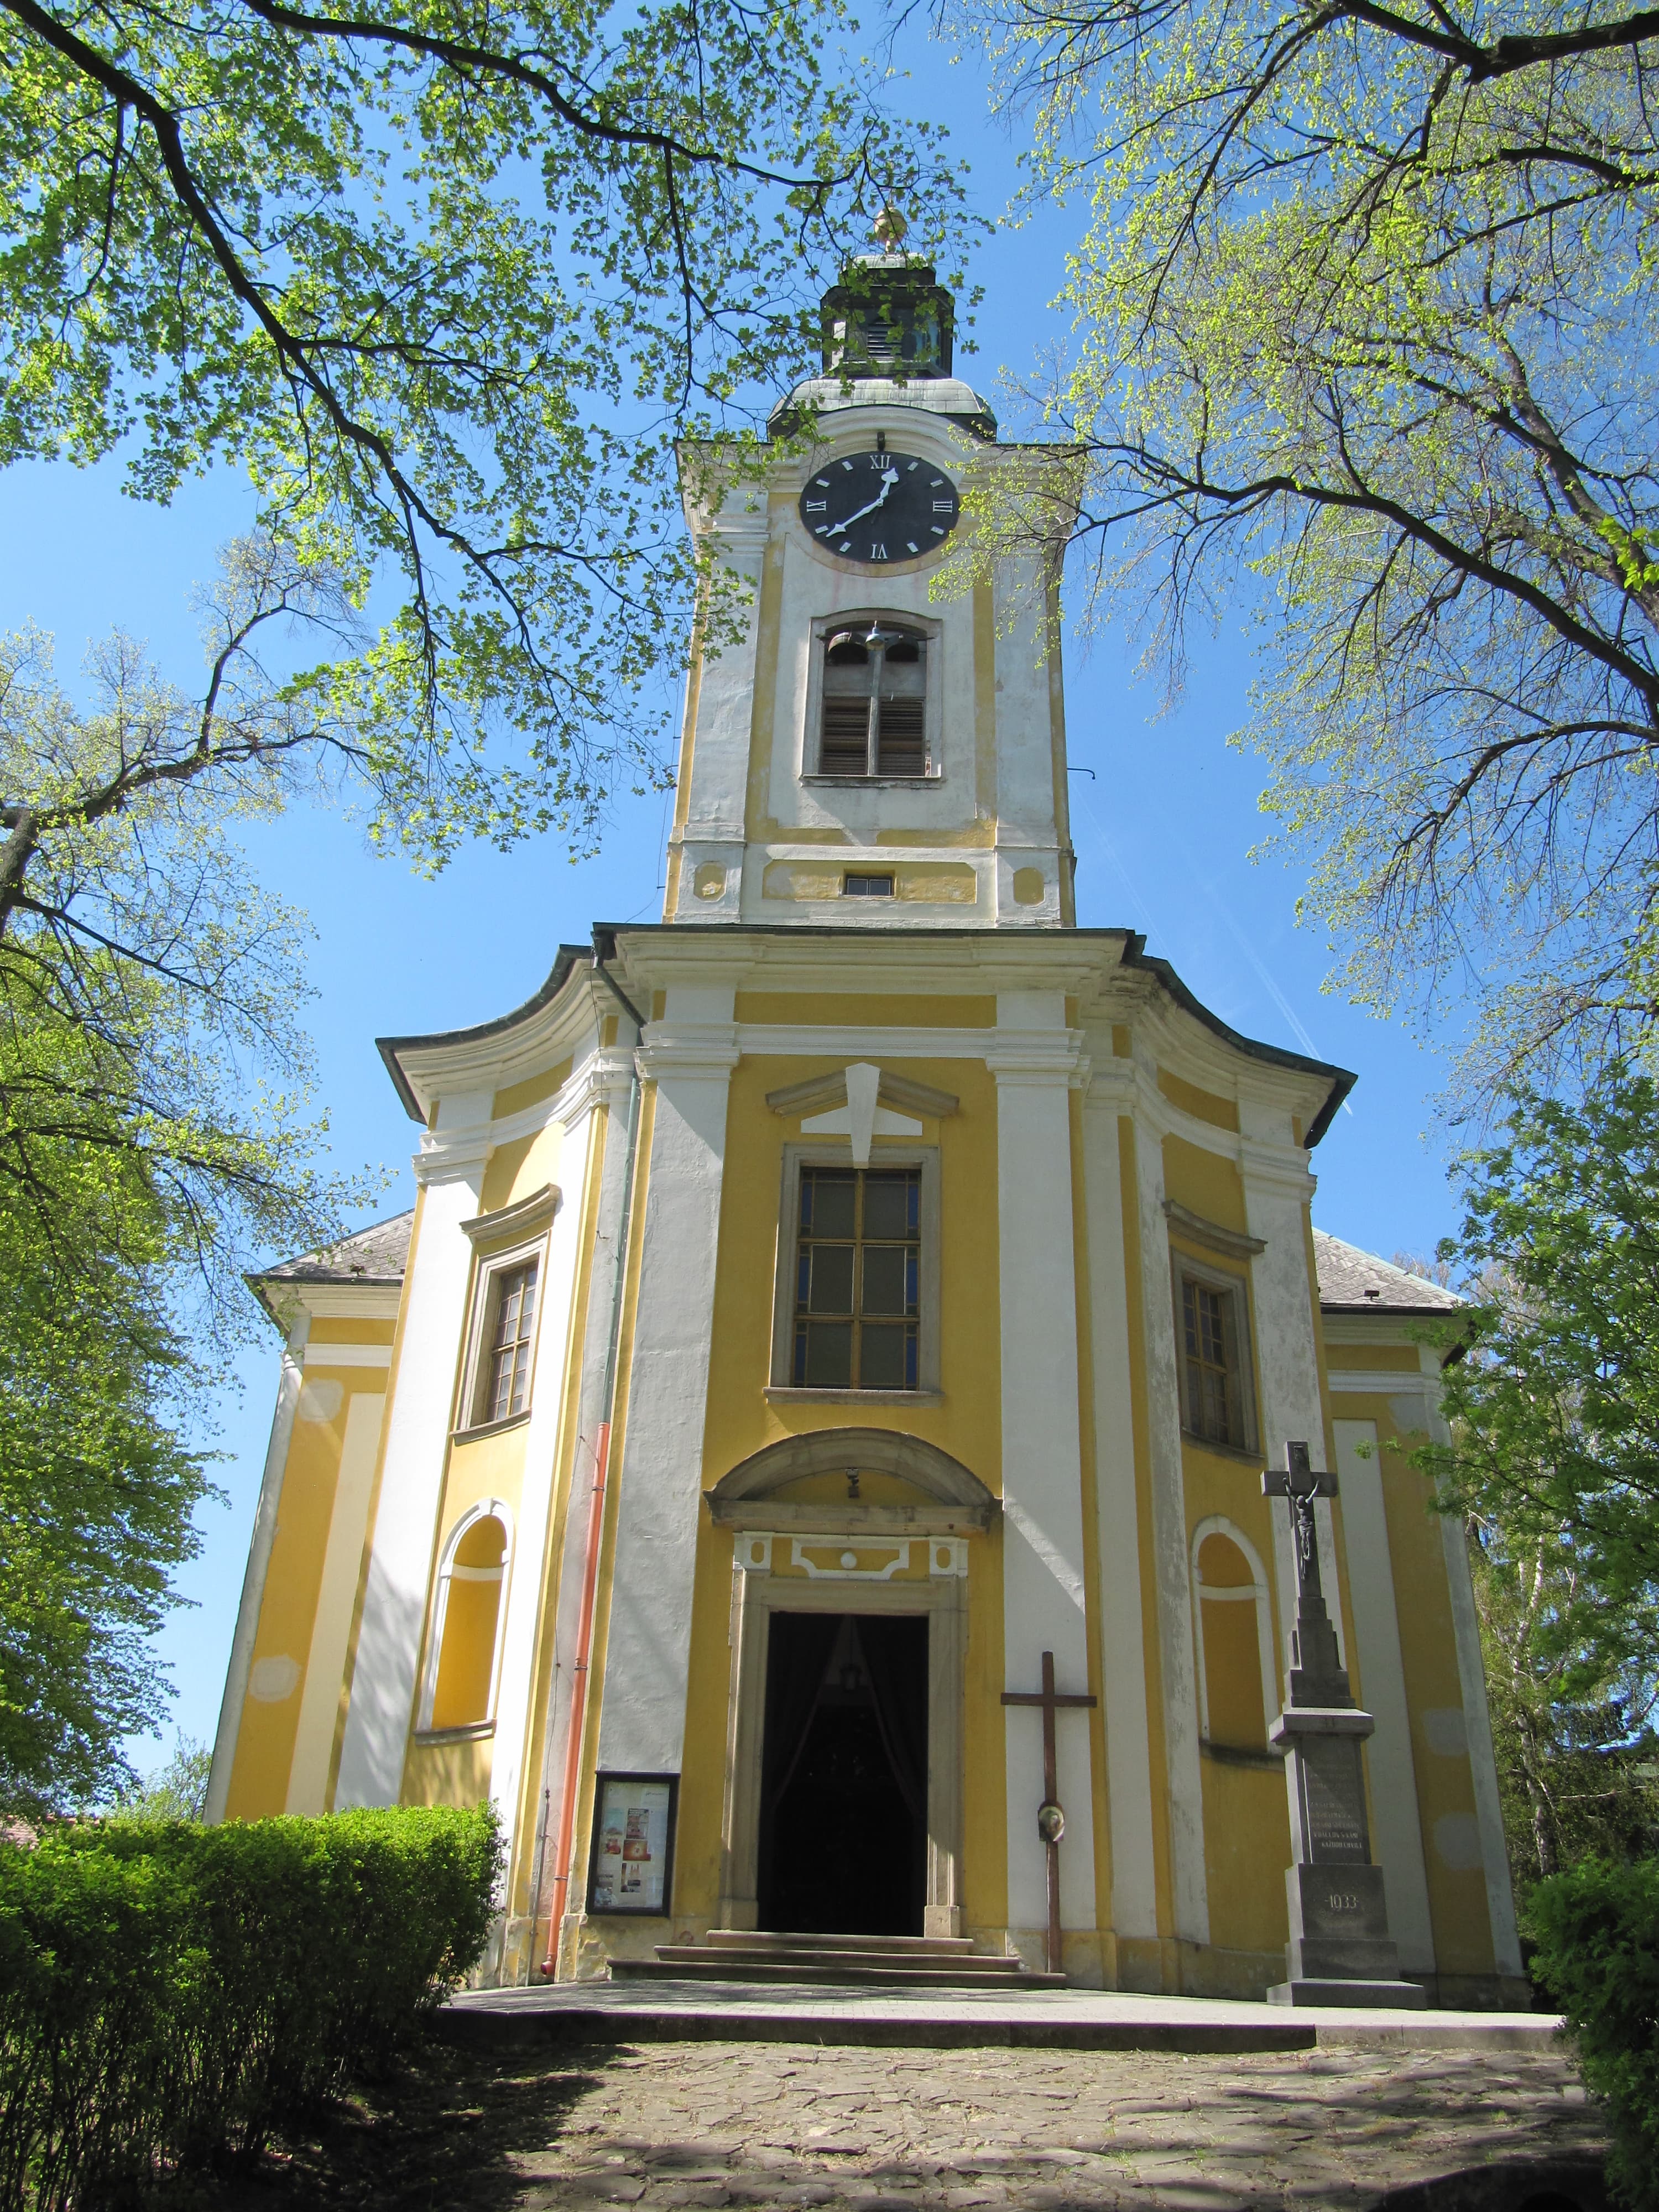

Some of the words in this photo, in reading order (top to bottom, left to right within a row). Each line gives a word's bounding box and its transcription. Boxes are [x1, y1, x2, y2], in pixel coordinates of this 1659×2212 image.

[869, 455, 891, 469] XII
[806, 500, 827, 513] IX
[932, 500, 953, 513] III
[870, 544, 888, 559] VI
